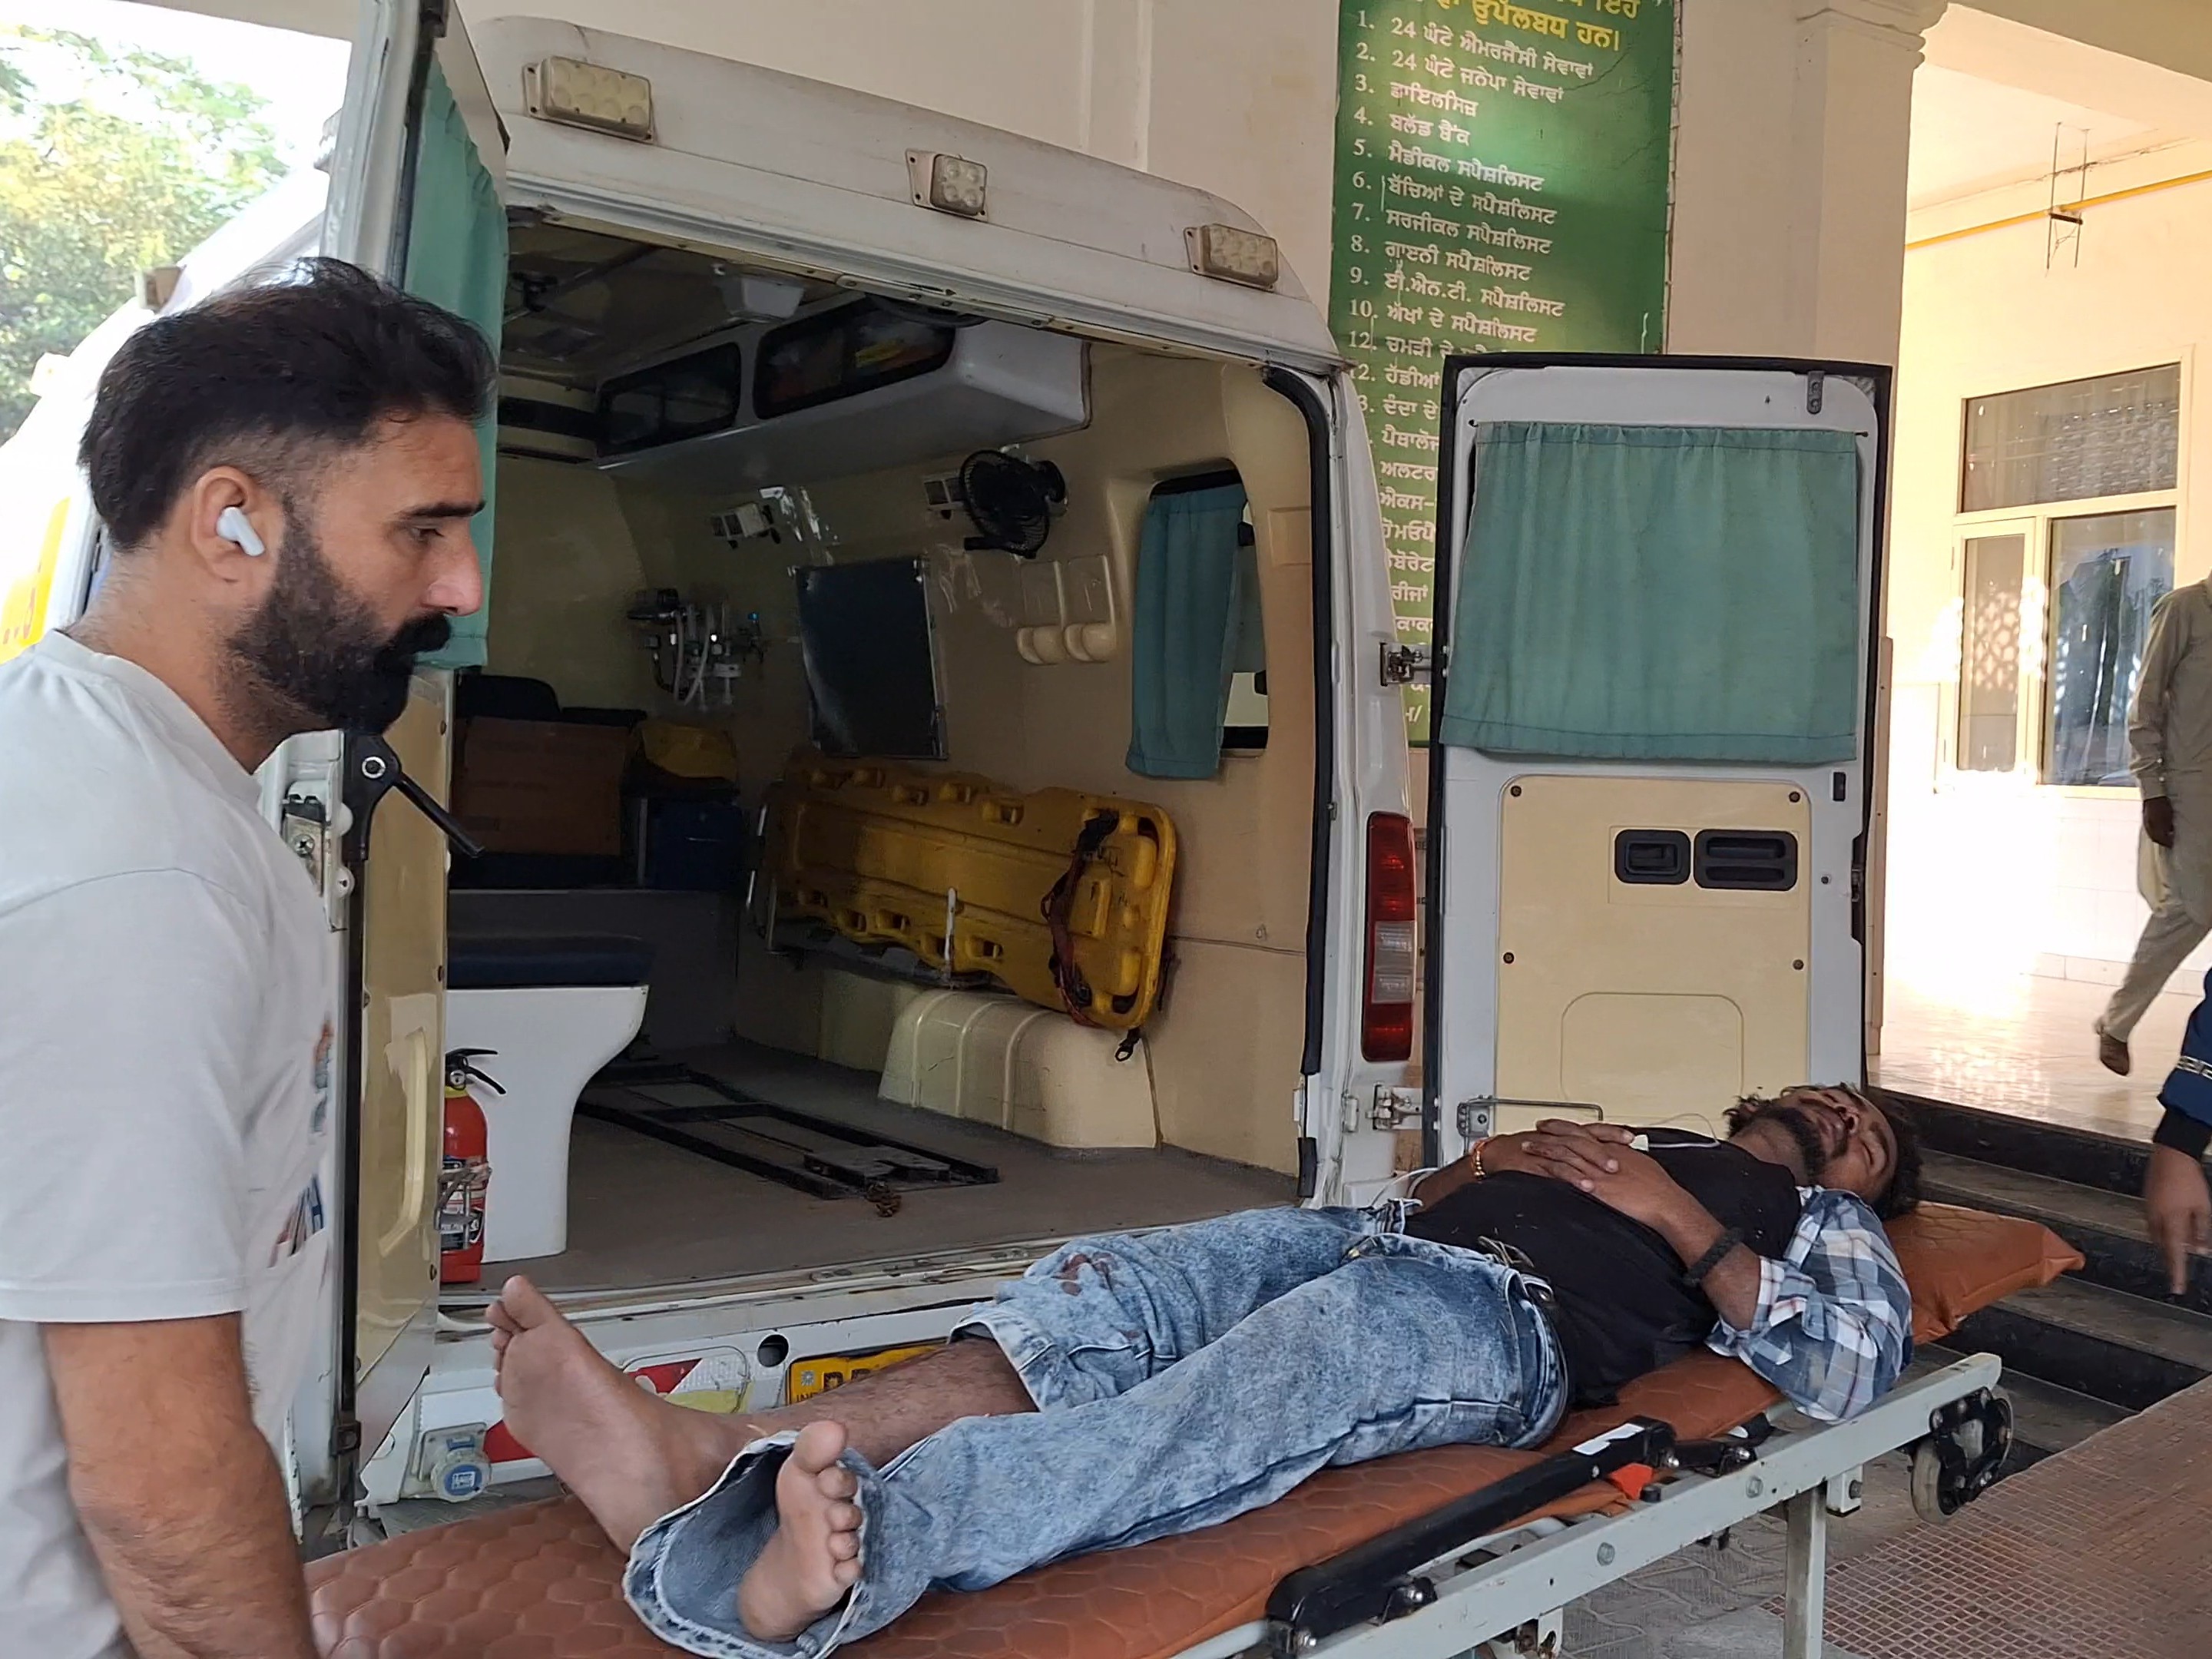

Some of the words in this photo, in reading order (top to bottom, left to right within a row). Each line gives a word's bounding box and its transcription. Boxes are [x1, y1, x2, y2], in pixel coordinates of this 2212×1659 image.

[1358, 10, 1375, 29] 1.
[1391, 17, 1416, 38] 24
[1423, 22, 1454, 47] ਘੰਟੇ
[1356, 41, 1376, 61] 2.
[1392, 50, 1417, 71] 24
[1425, 54, 1455, 78] ਘੰਟੇ
[1355, 74, 1375, 94] 3.
[1354, 106, 1373, 126] 4.
[1389, 113, 1434, 137] ਬਲੱਡ
[1439, 119, 1471, 146] ਬੈਂਕ
[1353, 138, 1372, 157] 5.
[1388, 140, 1451, 173] ਮੈਡੀਕਲ
[1353, 171, 1372, 190] 6.
[1449, 186, 1465, 207] ਦੇ
[1351, 203, 1370, 221] 7.
[1386, 208, 1460, 237] ਸਰਜੀਕਲ
[1351, 234, 1369, 253] 8.
[1350, 267, 1369, 285] 9.
[1350, 299, 1378, 319] 10.
[1429, 307, 1445, 328] ਦੇ
[1349, 330, 1377, 350] 12.
[1358, 395, 1375, 412] 3.
[1423, 399, 1439, 420] ਦੇ
[1380, 461, 1436, 481] ਅਲਟਰ
[1379, 485, 1435, 511] ਐਕਸ-
